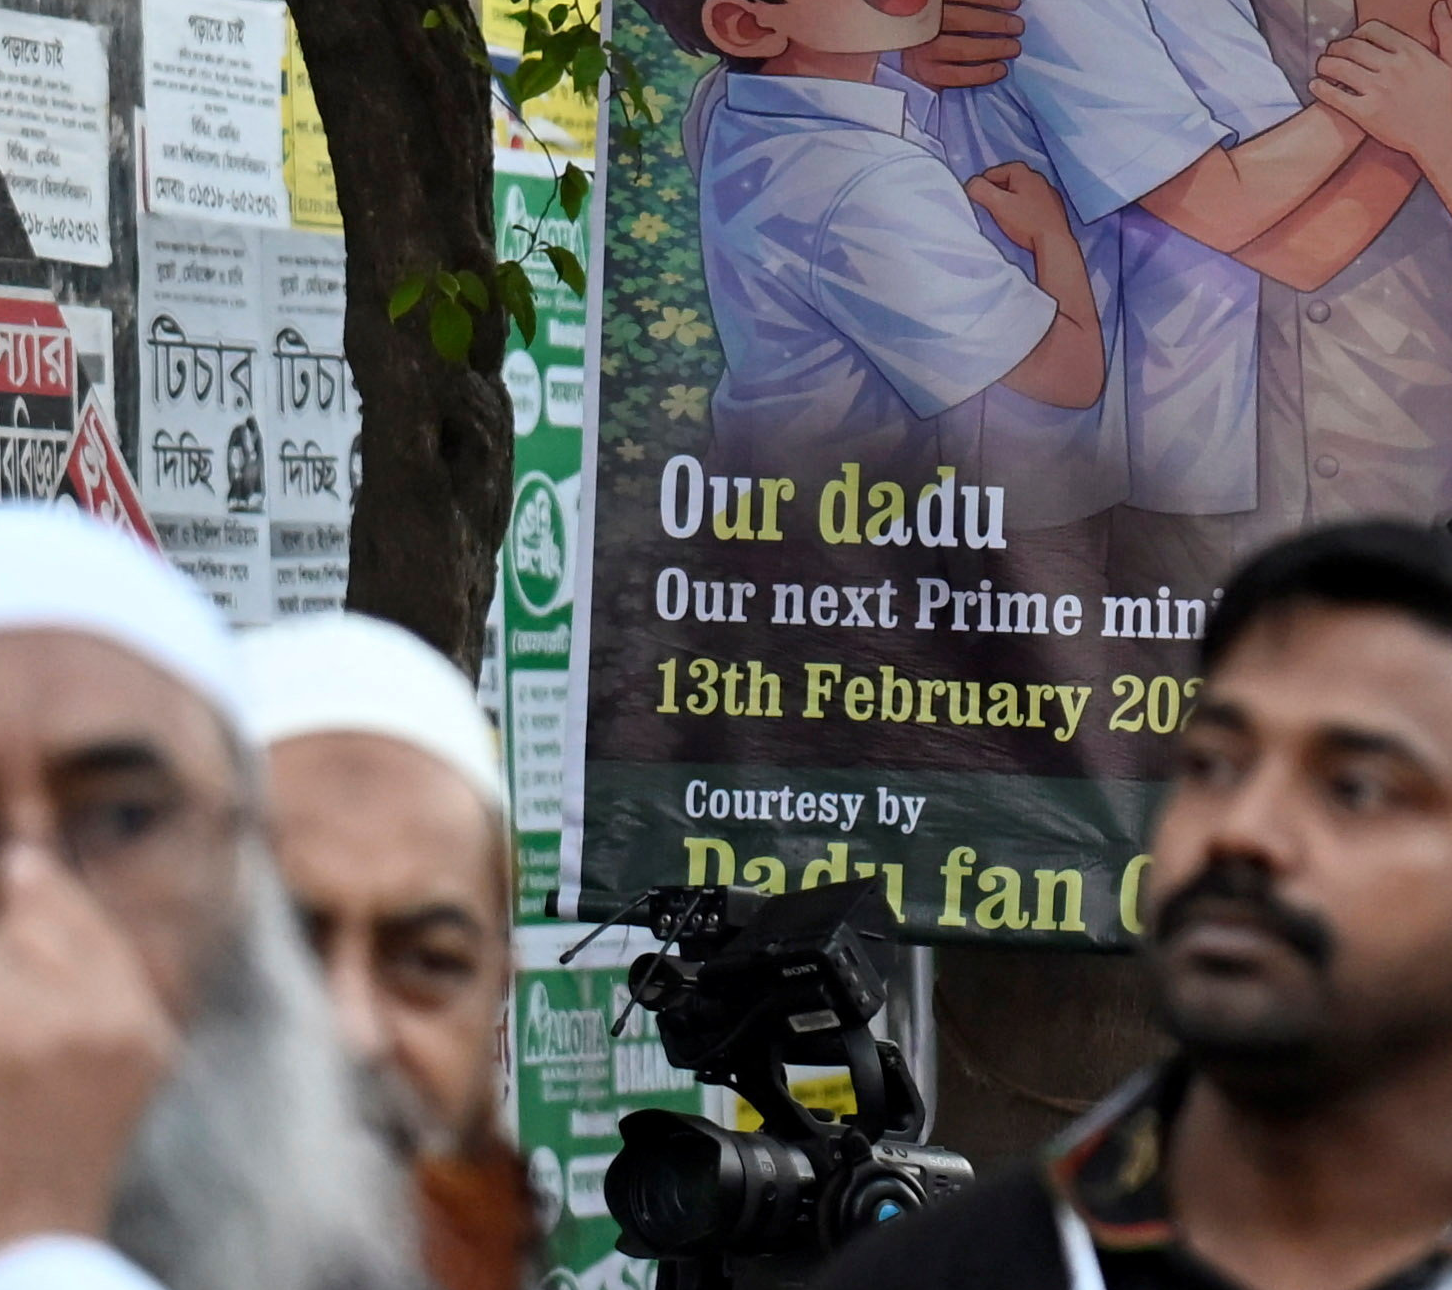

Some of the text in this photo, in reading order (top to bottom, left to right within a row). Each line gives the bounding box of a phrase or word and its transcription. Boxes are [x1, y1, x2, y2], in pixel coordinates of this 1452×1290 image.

[1, 35, 65, 69] পড়াতে চাই
[188, 14, 246, 46] পড়াতে চাই
[147, 313, 257, 411] টিচার
[273, 327, 347, 413] টিচা
[152, 428, 216, 497] দিচ্ছি
[279, 439, 341, 502] দিচ্ছি
[658, 453, 1008, 551] Our dadu
[654, 567, 756, 624] Our
[770, 578, 898, 630] next
[913, 578, 1084, 638] Prime
[655, 657, 785, 719] 13th
[801, 662, 1093, 743] February
[684, 779, 928, 835] Courtesy by
[938, 845, 1087, 933] fan
[781, 963, 819, 979] SONY
